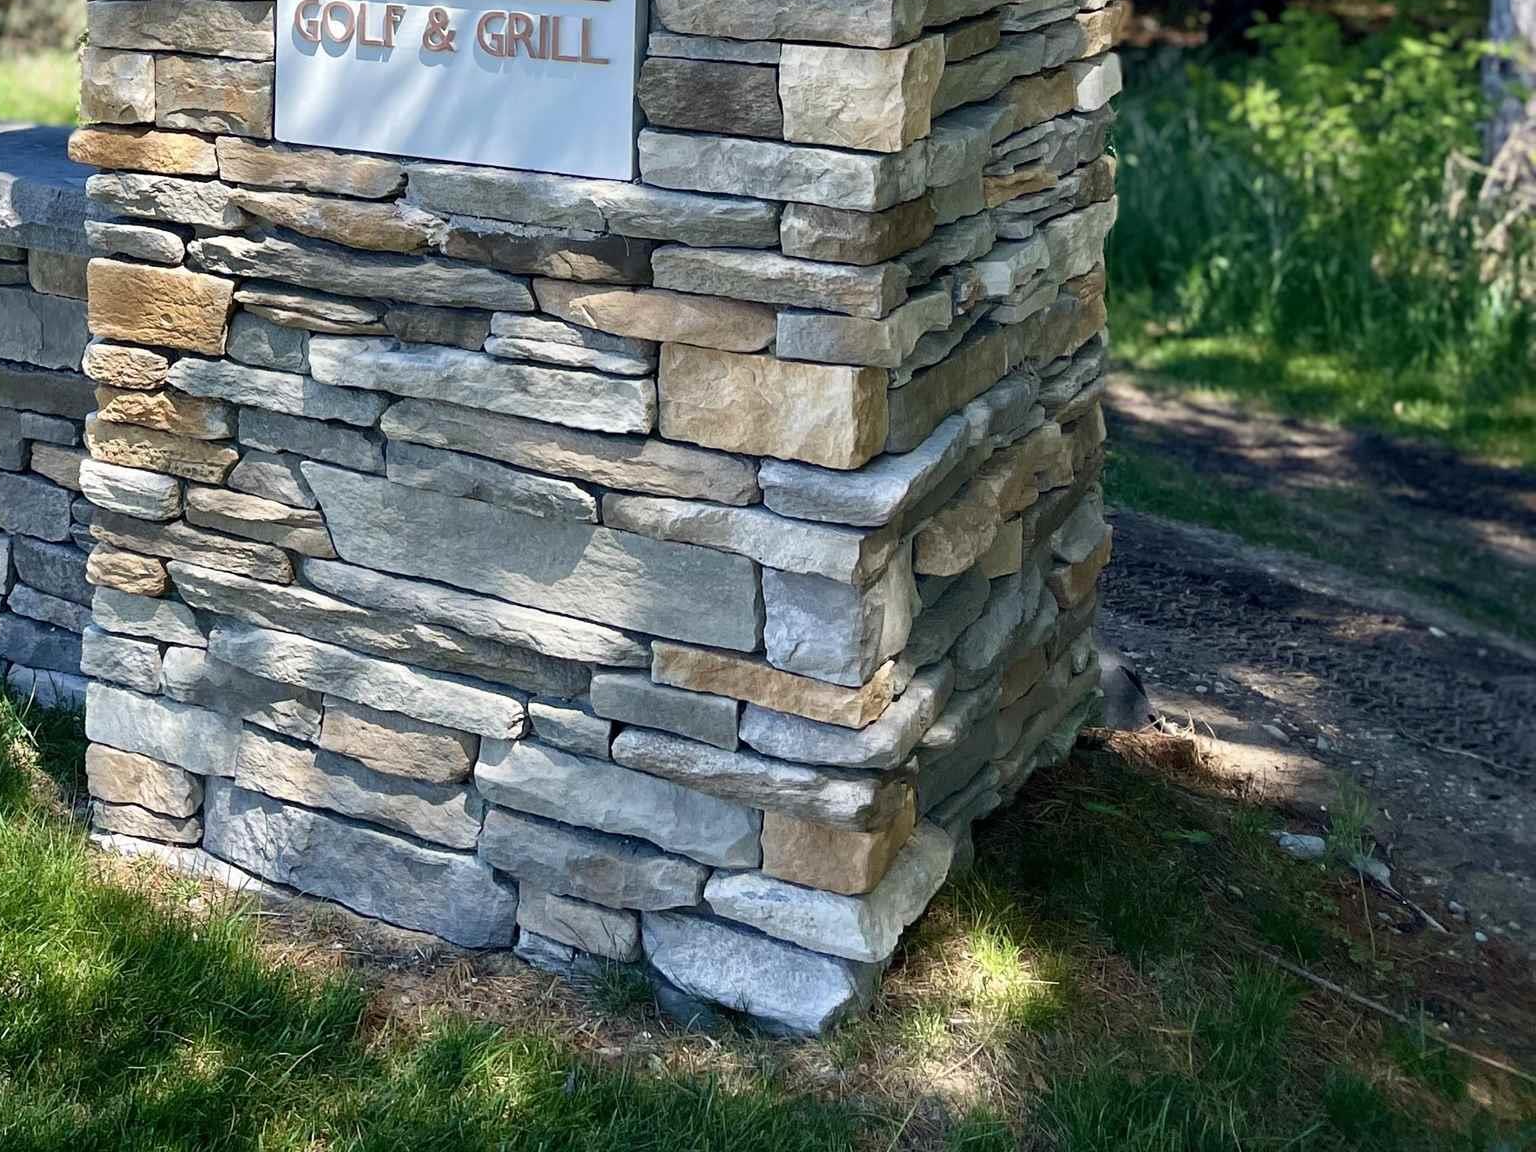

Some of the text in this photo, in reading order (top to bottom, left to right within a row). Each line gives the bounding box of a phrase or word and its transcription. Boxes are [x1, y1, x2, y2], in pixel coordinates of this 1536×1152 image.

[293, 0, 611, 65] GOLF & GRILL
